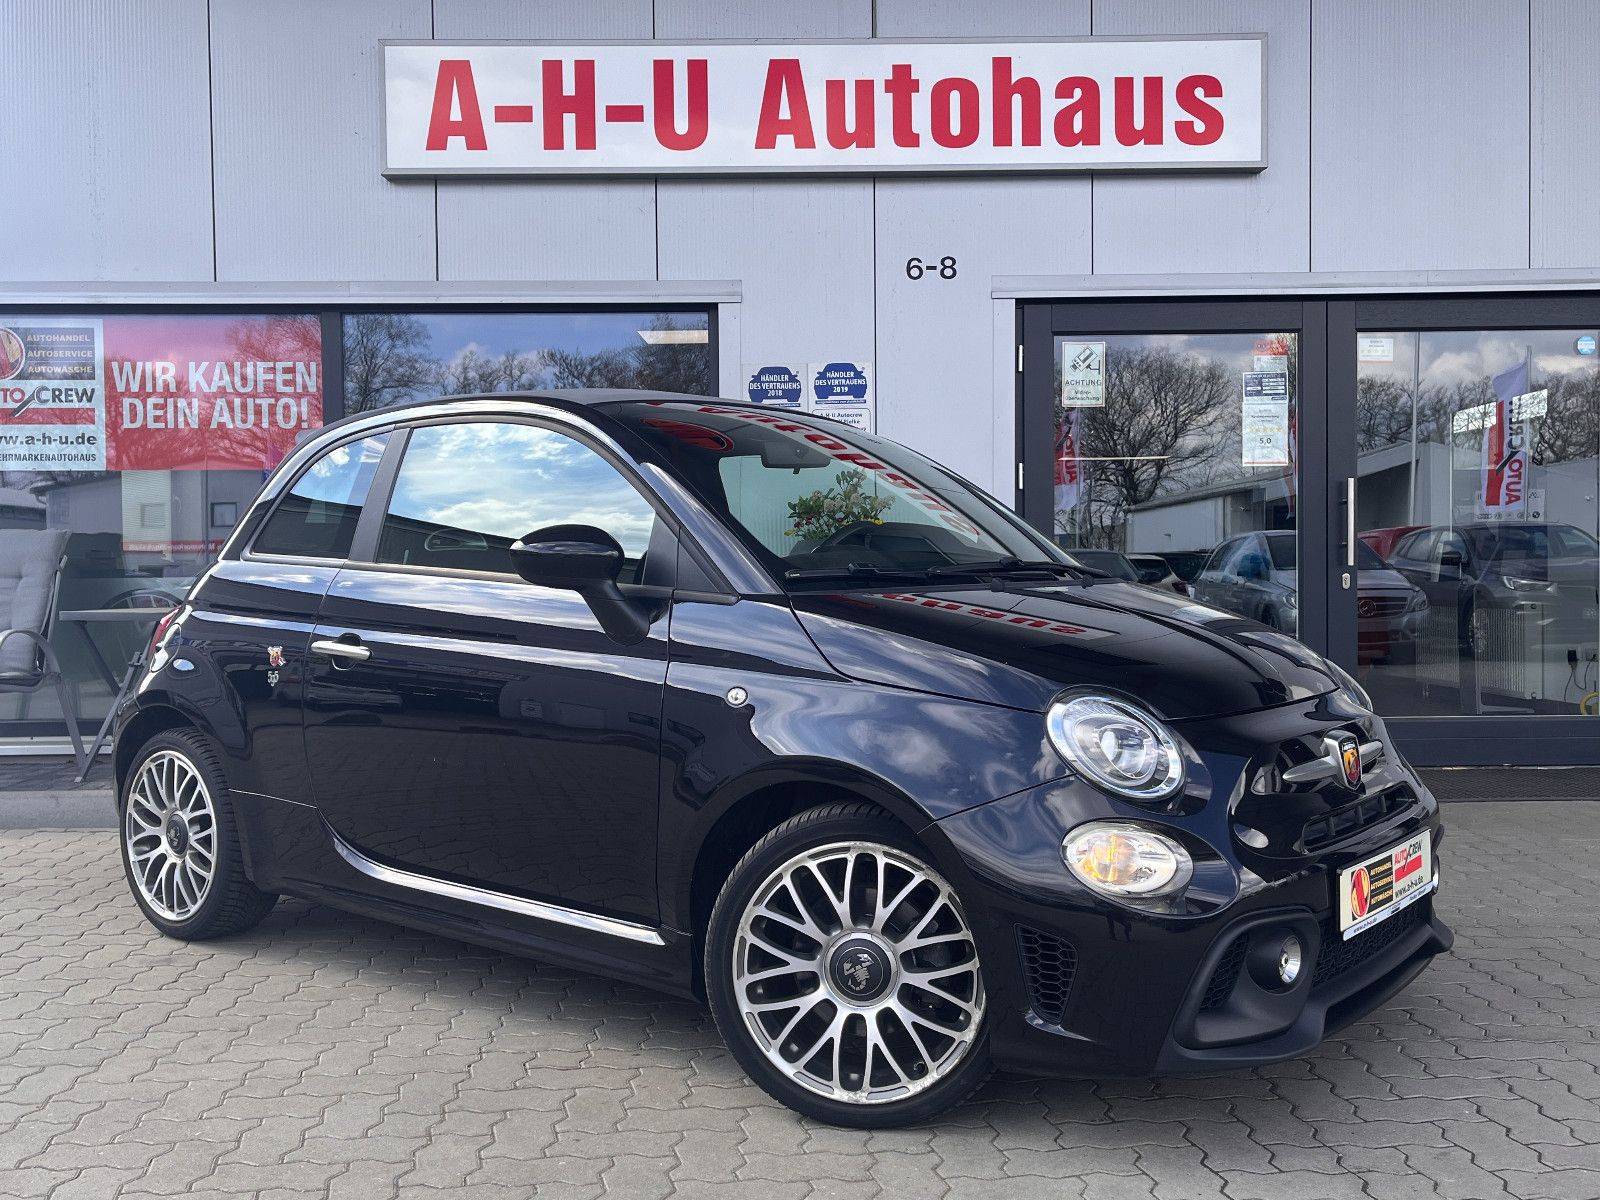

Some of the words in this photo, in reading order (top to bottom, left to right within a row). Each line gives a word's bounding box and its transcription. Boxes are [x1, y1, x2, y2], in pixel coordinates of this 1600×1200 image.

[425, 58, 709, 151] A-H-U
[754, 56, 1226, 151] Autohaus
[905, 256, 958, 281] 6-8
[26, 334, 91, 342] AUTOHANDEL
[27, 350, 93, 358] AUTOSERVICE
[111, 361, 177, 393] WIR
[188, 361, 317, 393] KAUFEN
[760, 374, 789, 382] HÄNDLER
[826, 370, 855, 378] HÄNDLER
[749, 382, 761, 390] DES
[761, 382, 800, 390] VERTRAUENS
[827, 378, 866, 386] VERTRAUENS
[35, 385, 96, 404] CREW
[122, 398, 199, 429] DEIN
[210, 397, 309, 429] AUTO!
